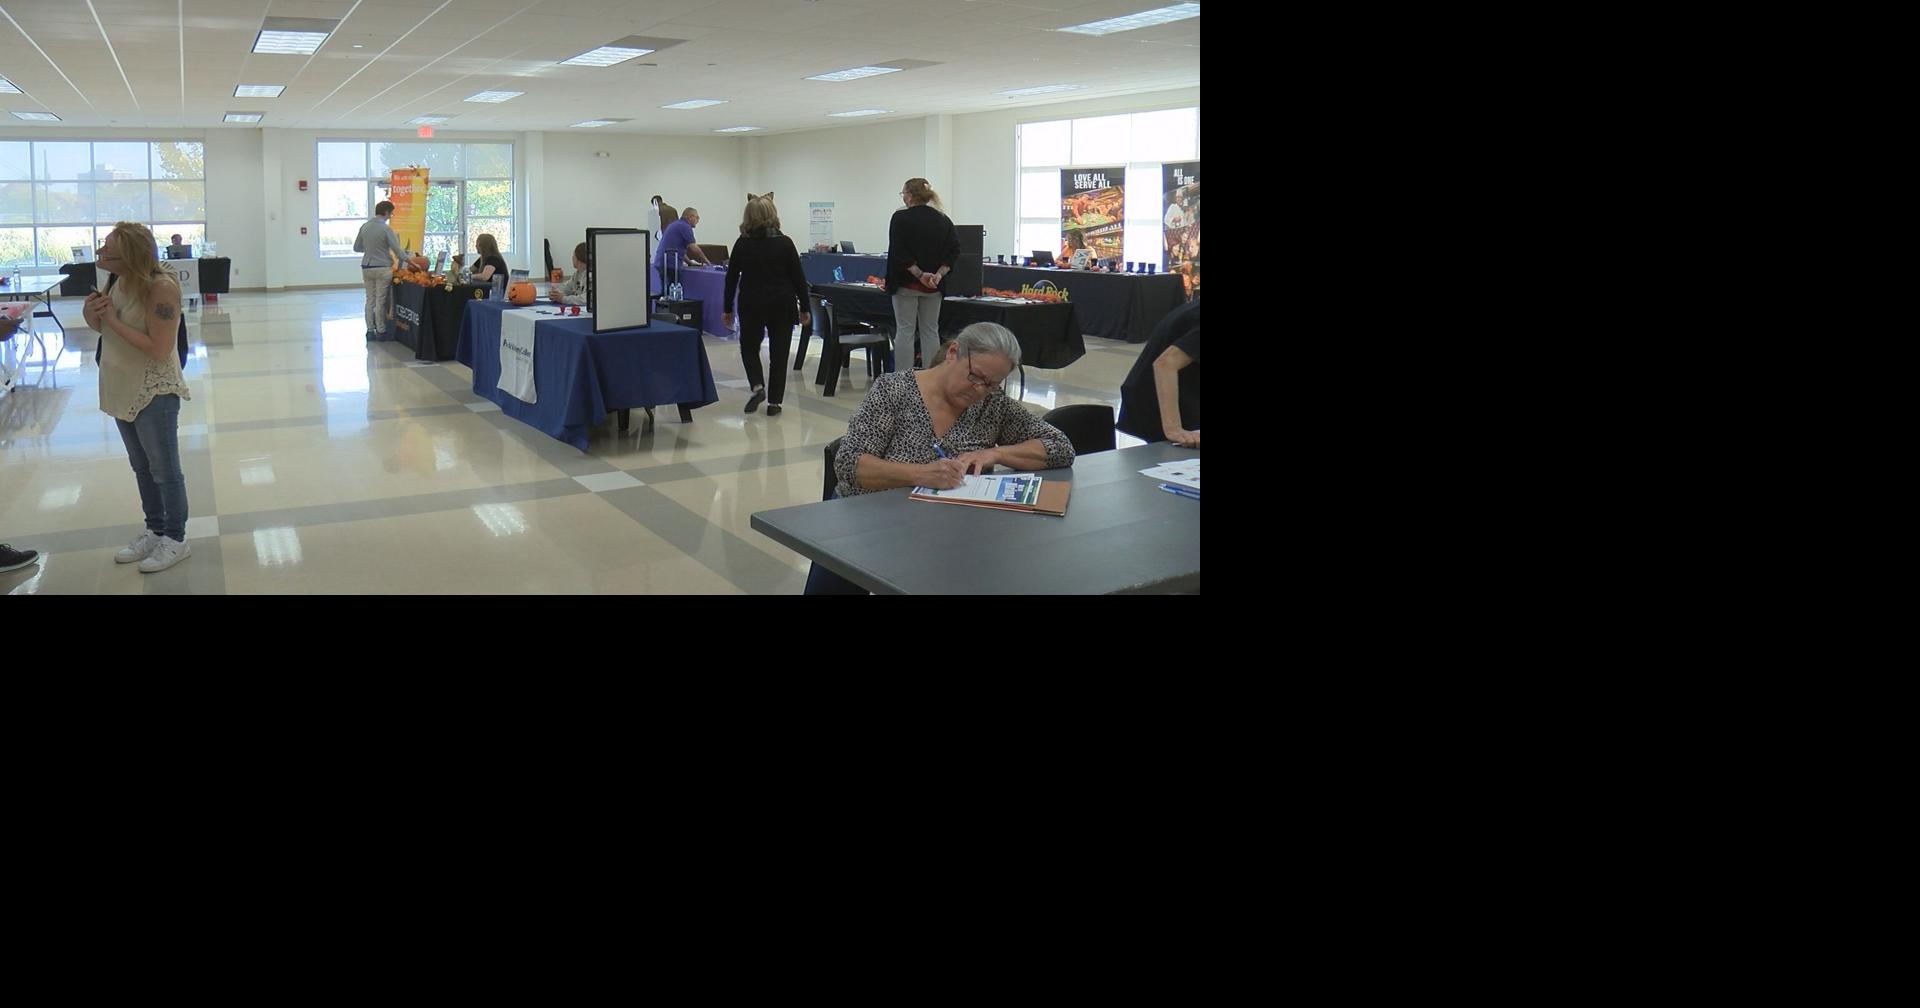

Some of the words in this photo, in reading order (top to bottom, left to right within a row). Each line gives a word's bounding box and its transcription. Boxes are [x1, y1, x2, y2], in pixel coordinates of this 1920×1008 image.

[1074, 174, 1092, 182] LOVE
[1178, 177, 1184, 185] IS
[1184, 176, 1195, 185] ONE
[1074, 181, 1097, 189] SERVE
[1098, 181, 1112, 189] ALL
[1022, 283, 1045, 296] Hard
[1046, 285, 1069, 302] Rock
